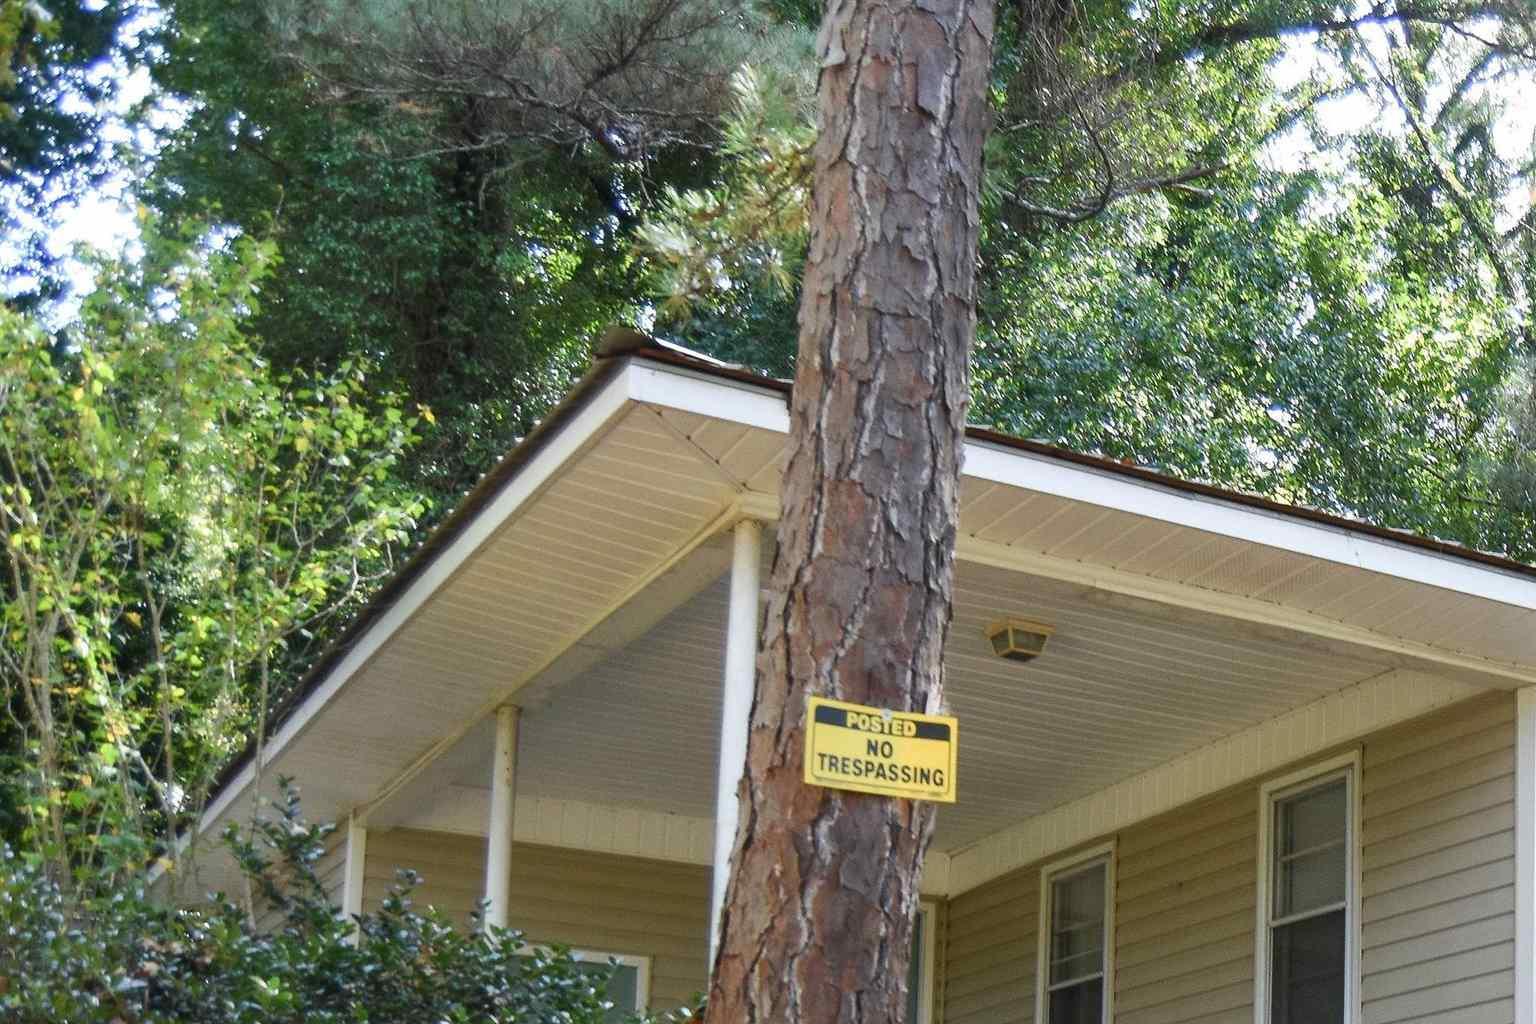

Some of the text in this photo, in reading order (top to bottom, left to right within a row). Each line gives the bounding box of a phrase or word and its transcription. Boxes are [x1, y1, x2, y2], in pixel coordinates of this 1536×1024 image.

[846, 711, 917, 737] POSTED
[866, 739, 893, 759] NO
[818, 752, 944, 787] TRESPASSING
